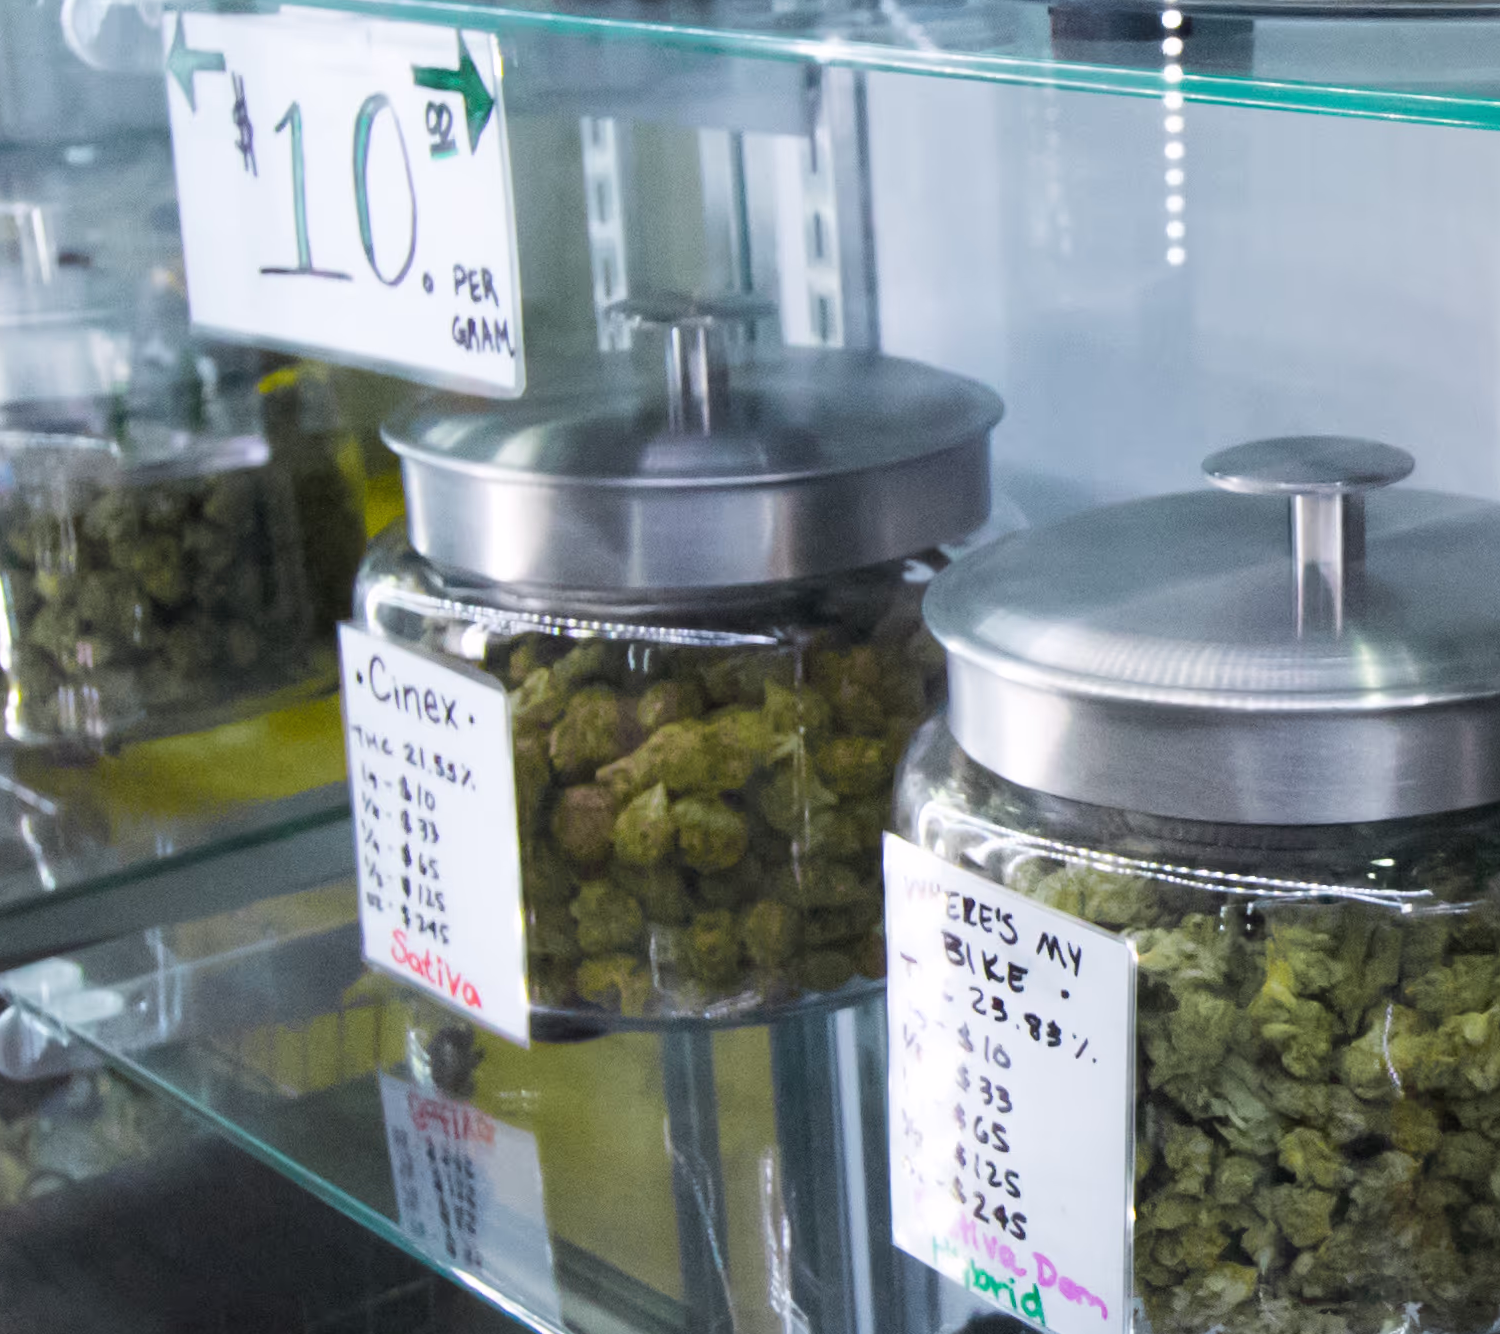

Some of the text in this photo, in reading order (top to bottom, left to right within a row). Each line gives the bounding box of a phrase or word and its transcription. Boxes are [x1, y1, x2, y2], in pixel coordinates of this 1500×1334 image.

[453, 264, 499, 307] PER
[451, 315, 516, 358] GRAM
[368, 652, 458, 731] Cinex
[391, 928, 483, 1010] Sativa
[940, 928, 1030, 995] BIKE
[1035, 931, 1084, 978] MY
[1031, 1250, 1109, 1323] Dom
